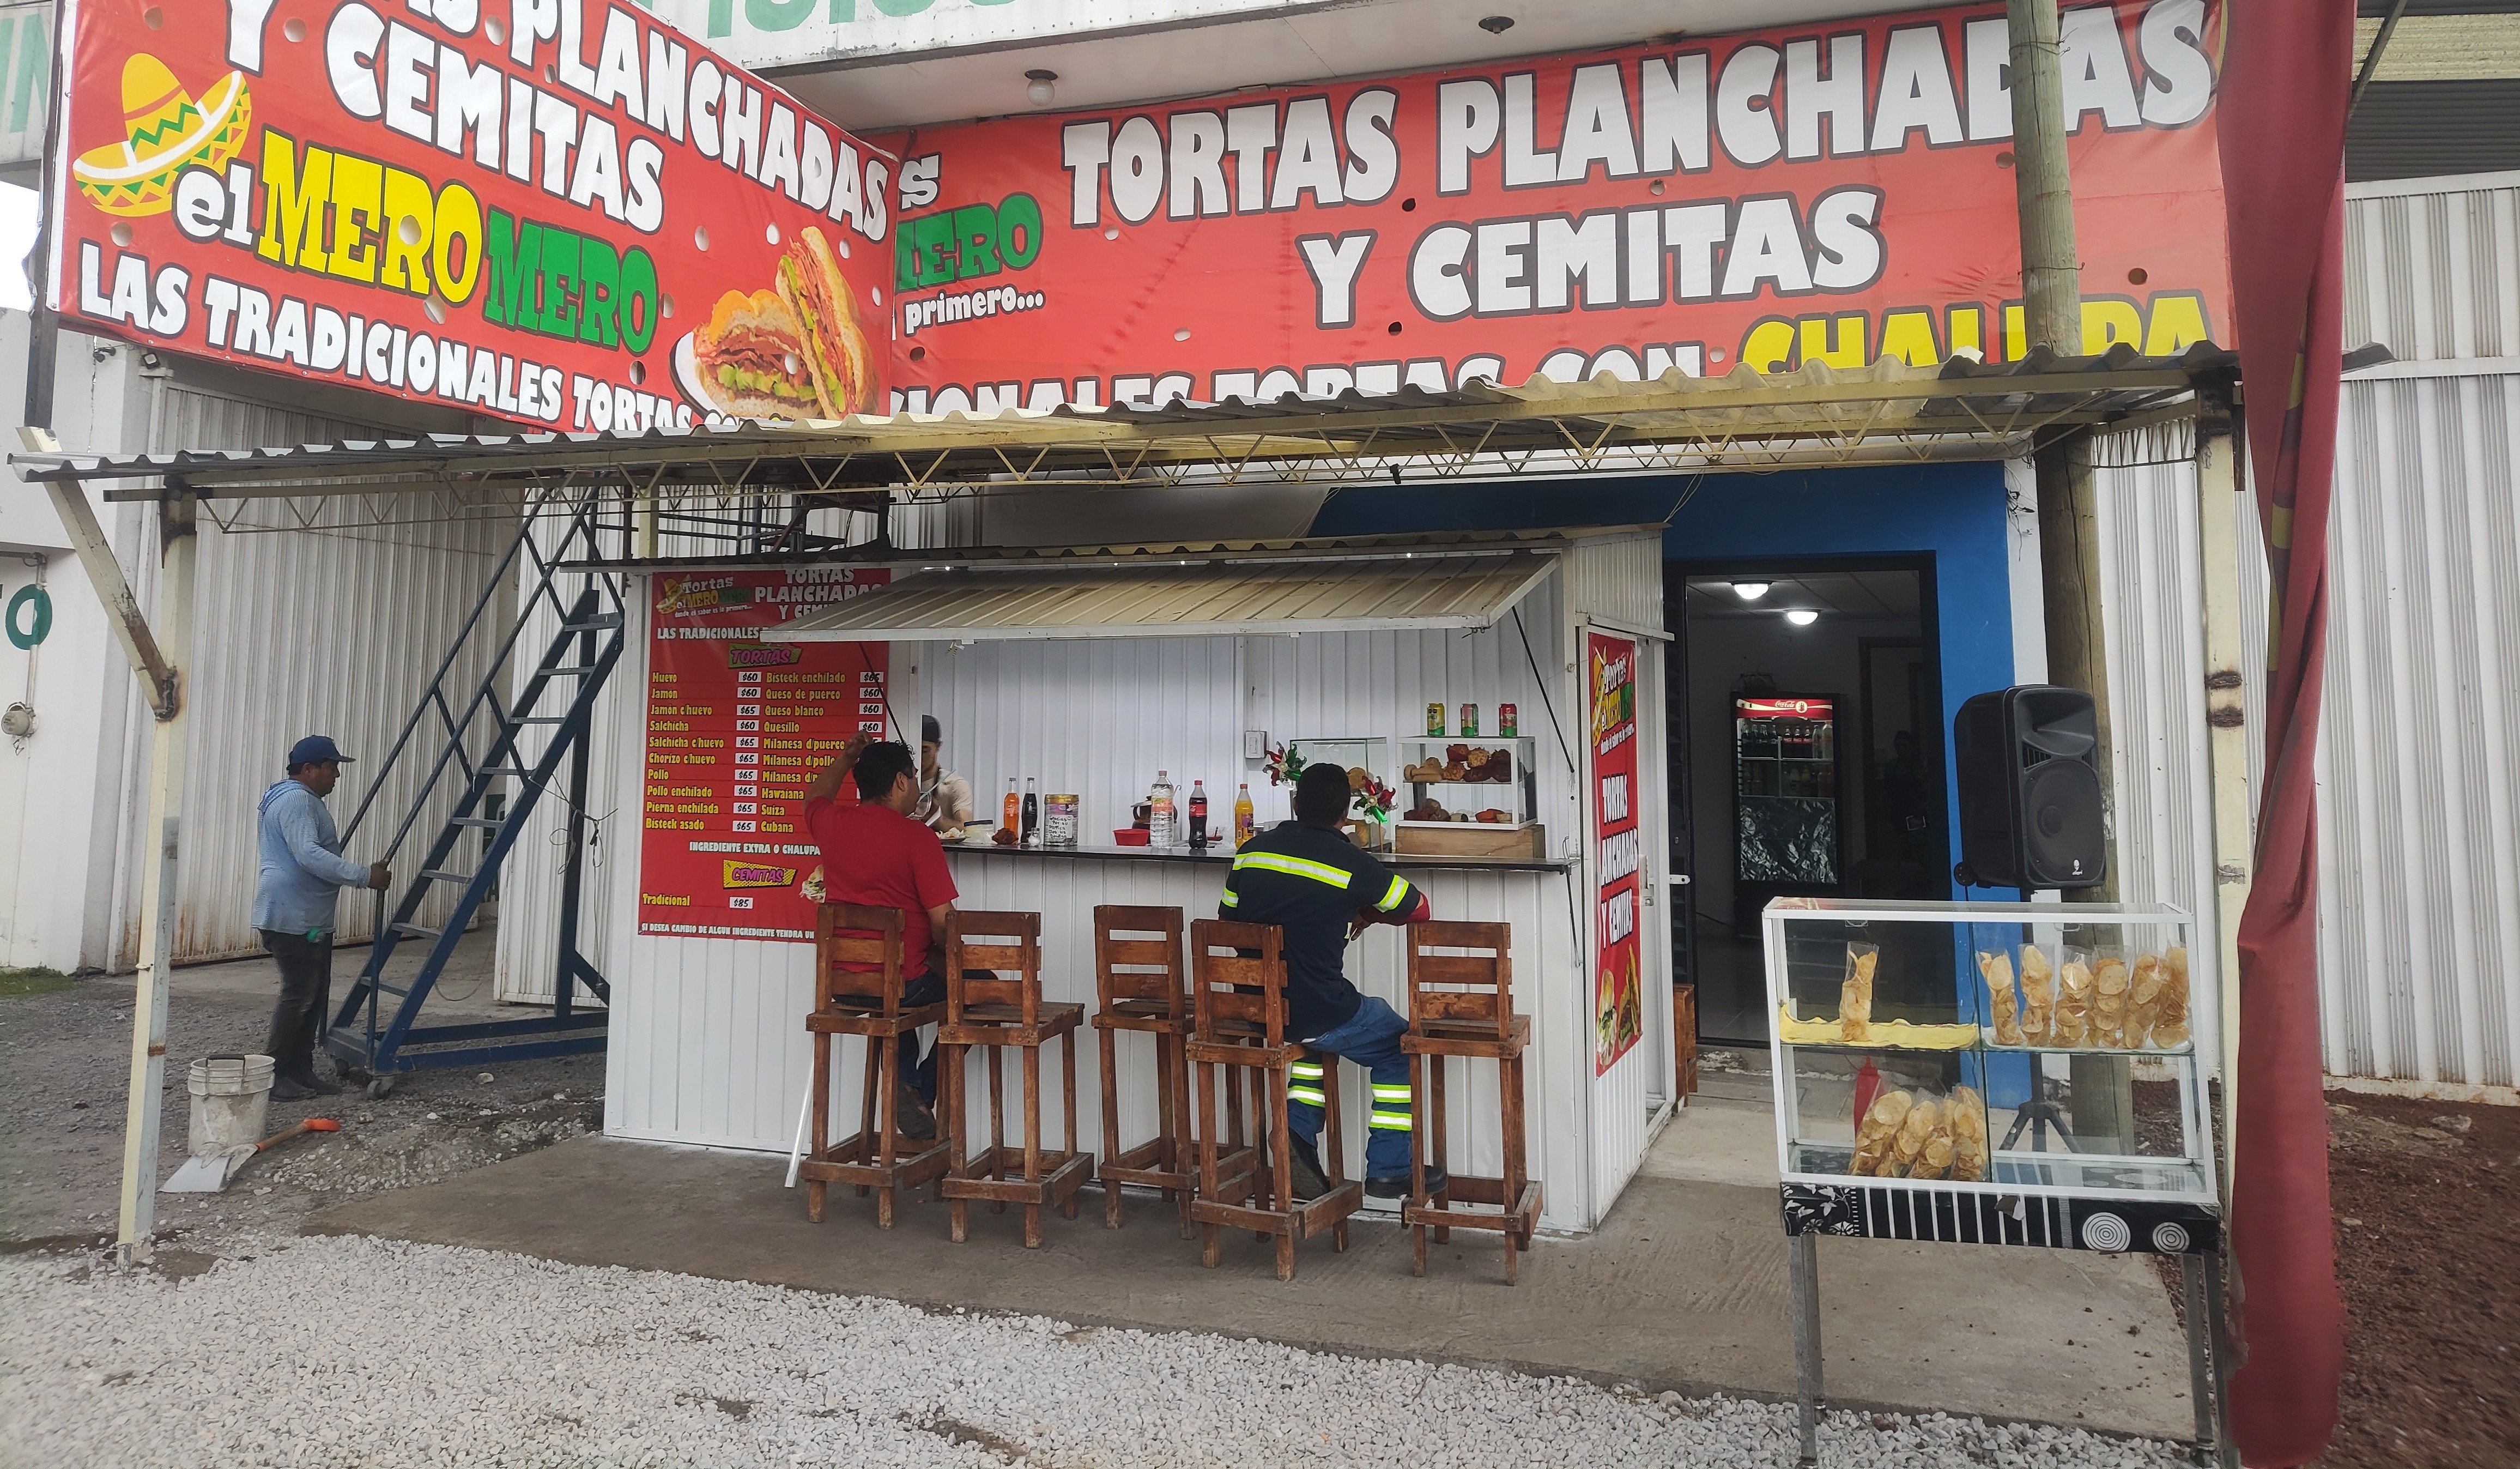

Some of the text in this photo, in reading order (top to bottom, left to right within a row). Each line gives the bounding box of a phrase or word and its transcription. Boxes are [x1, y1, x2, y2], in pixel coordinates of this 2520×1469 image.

[227, 0, 664, 232] Y CEMITAS
[1062, 0, 2212, 225] TORTAS PLANCHADAS
[510, 0, 888, 241] PLANCHADAS
[176, 130, 658, 352] el MERO MERO
[1301, 191, 1880, 324] Y CEMITAS
[905, 287, 1044, 334] primero...
[82, 242, 190, 335] LAS
[205, 279, 562, 420] TRADICIONALES
[1743, 296, 2208, 374] CHALPA
[785, 569, 854, 584] TORTAS
[683, 576, 734, 594] Tortas
[687, 590, 718, 608] MERO
[779, 605, 789, 619] Y
[658, 627, 759, 639] LAS TRADICIONALES
[731, 649, 790, 664] TORTAS
[652, 673, 677, 682] Huevo
[743, 673, 758, 681] $60
[766, 672, 846, 682] Bisteck enchilado
[1604, 655, 1626, 693] Tortas
[741, 688, 757, 697] $60
[766, 688, 840, 701] Queso de puerco
[864, 689, 879, 698] $60
[681, 705, 712, 715] c/huevo
[741, 706, 756, 715] $65
[765, 705, 823, 716] Queso blanco
[863, 705, 879, 714] $60
[650, 721, 689, 731] Salchicha
[740, 722, 755, 730] $60
[764, 722, 799, 732] Quesillo
[649, 736, 724, 748] Salchicha c/huevo
[740, 738, 755, 746] $65
[764, 738, 802, 749] Milanesa
[649, 753, 715, 764] Chorizo c/huevo
[740, 754, 754, 763] $65
[763, 754, 801, 765] Milanesa
[648, 769, 669, 779] Pollo
[739, 771, 753, 779] $65
[762, 771, 801, 782] Milanesa
[647, 785, 712, 797] Pollo enchilado
[738, 787, 753, 795] $65
[762, 788, 804, 799] Hawaiana
[1602, 774, 1628, 823] TORTAS
[646, 802, 718, 814] Pierna enchilada
[737, 804, 753, 812] $65
[646, 818, 704, 830] Bisteck asado
[737, 822, 751, 831] $65
[761, 821, 793, 832] Cubana
[690, 842, 741, 853] INGREDIENTE
[743, 843, 770, 854] EXTRA
[732, 868, 784, 882] CEMITAS
[643, 893, 690, 906] Tradicional
[1601, 888, 1632, 948] Y CEMITAS
[642, 923, 648, 931] SI
[650, 923, 669, 932] DESEA
[671, 924, 696, 933] CAMBIO
[699, 926, 707, 934] DE
[732, 928, 775, 937] INGREDIENTE
[777, 929, 802, 938] TENDRA
